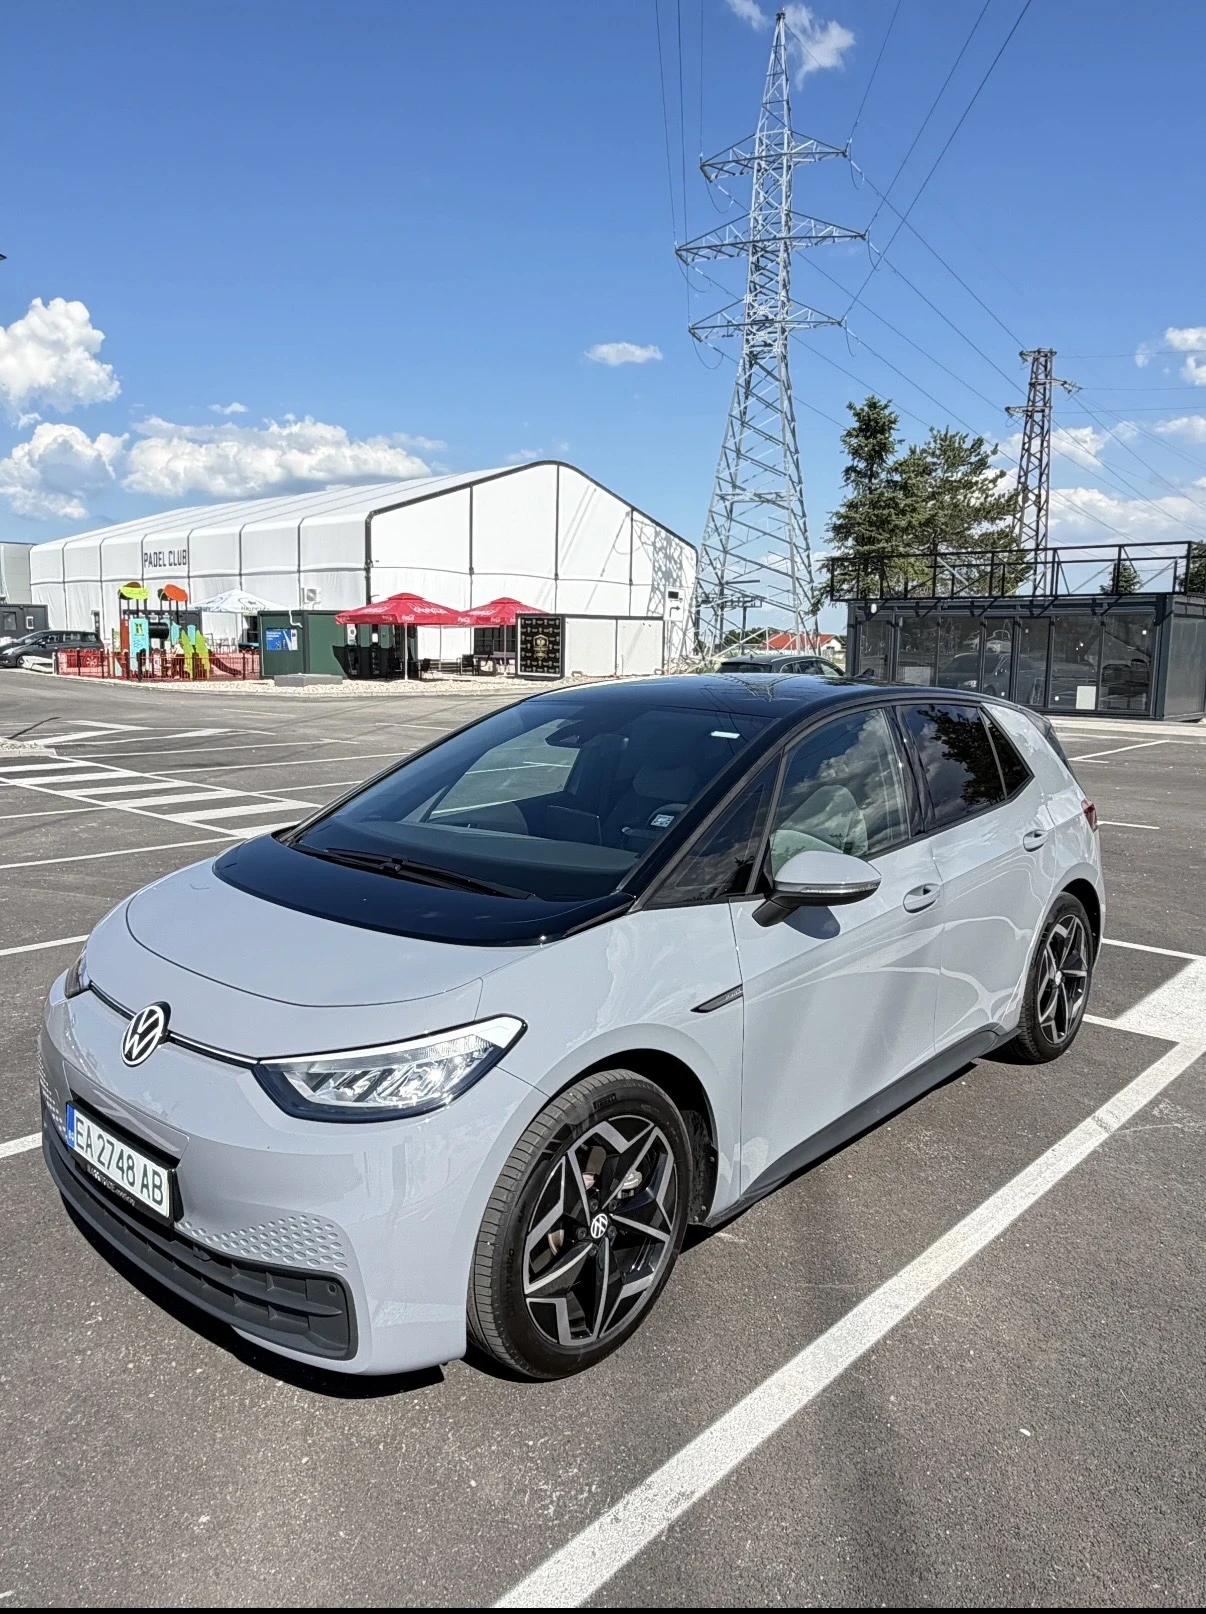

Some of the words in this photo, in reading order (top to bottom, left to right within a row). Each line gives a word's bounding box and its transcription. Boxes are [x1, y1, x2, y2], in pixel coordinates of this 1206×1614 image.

[143, 551, 167, 568] PADEL
[168, 549, 187, 567] CLUB
[75, 1116, 94, 1159] EA
[97, 1133, 136, 1188] 2748
[140, 1163, 164, 1207] AB
